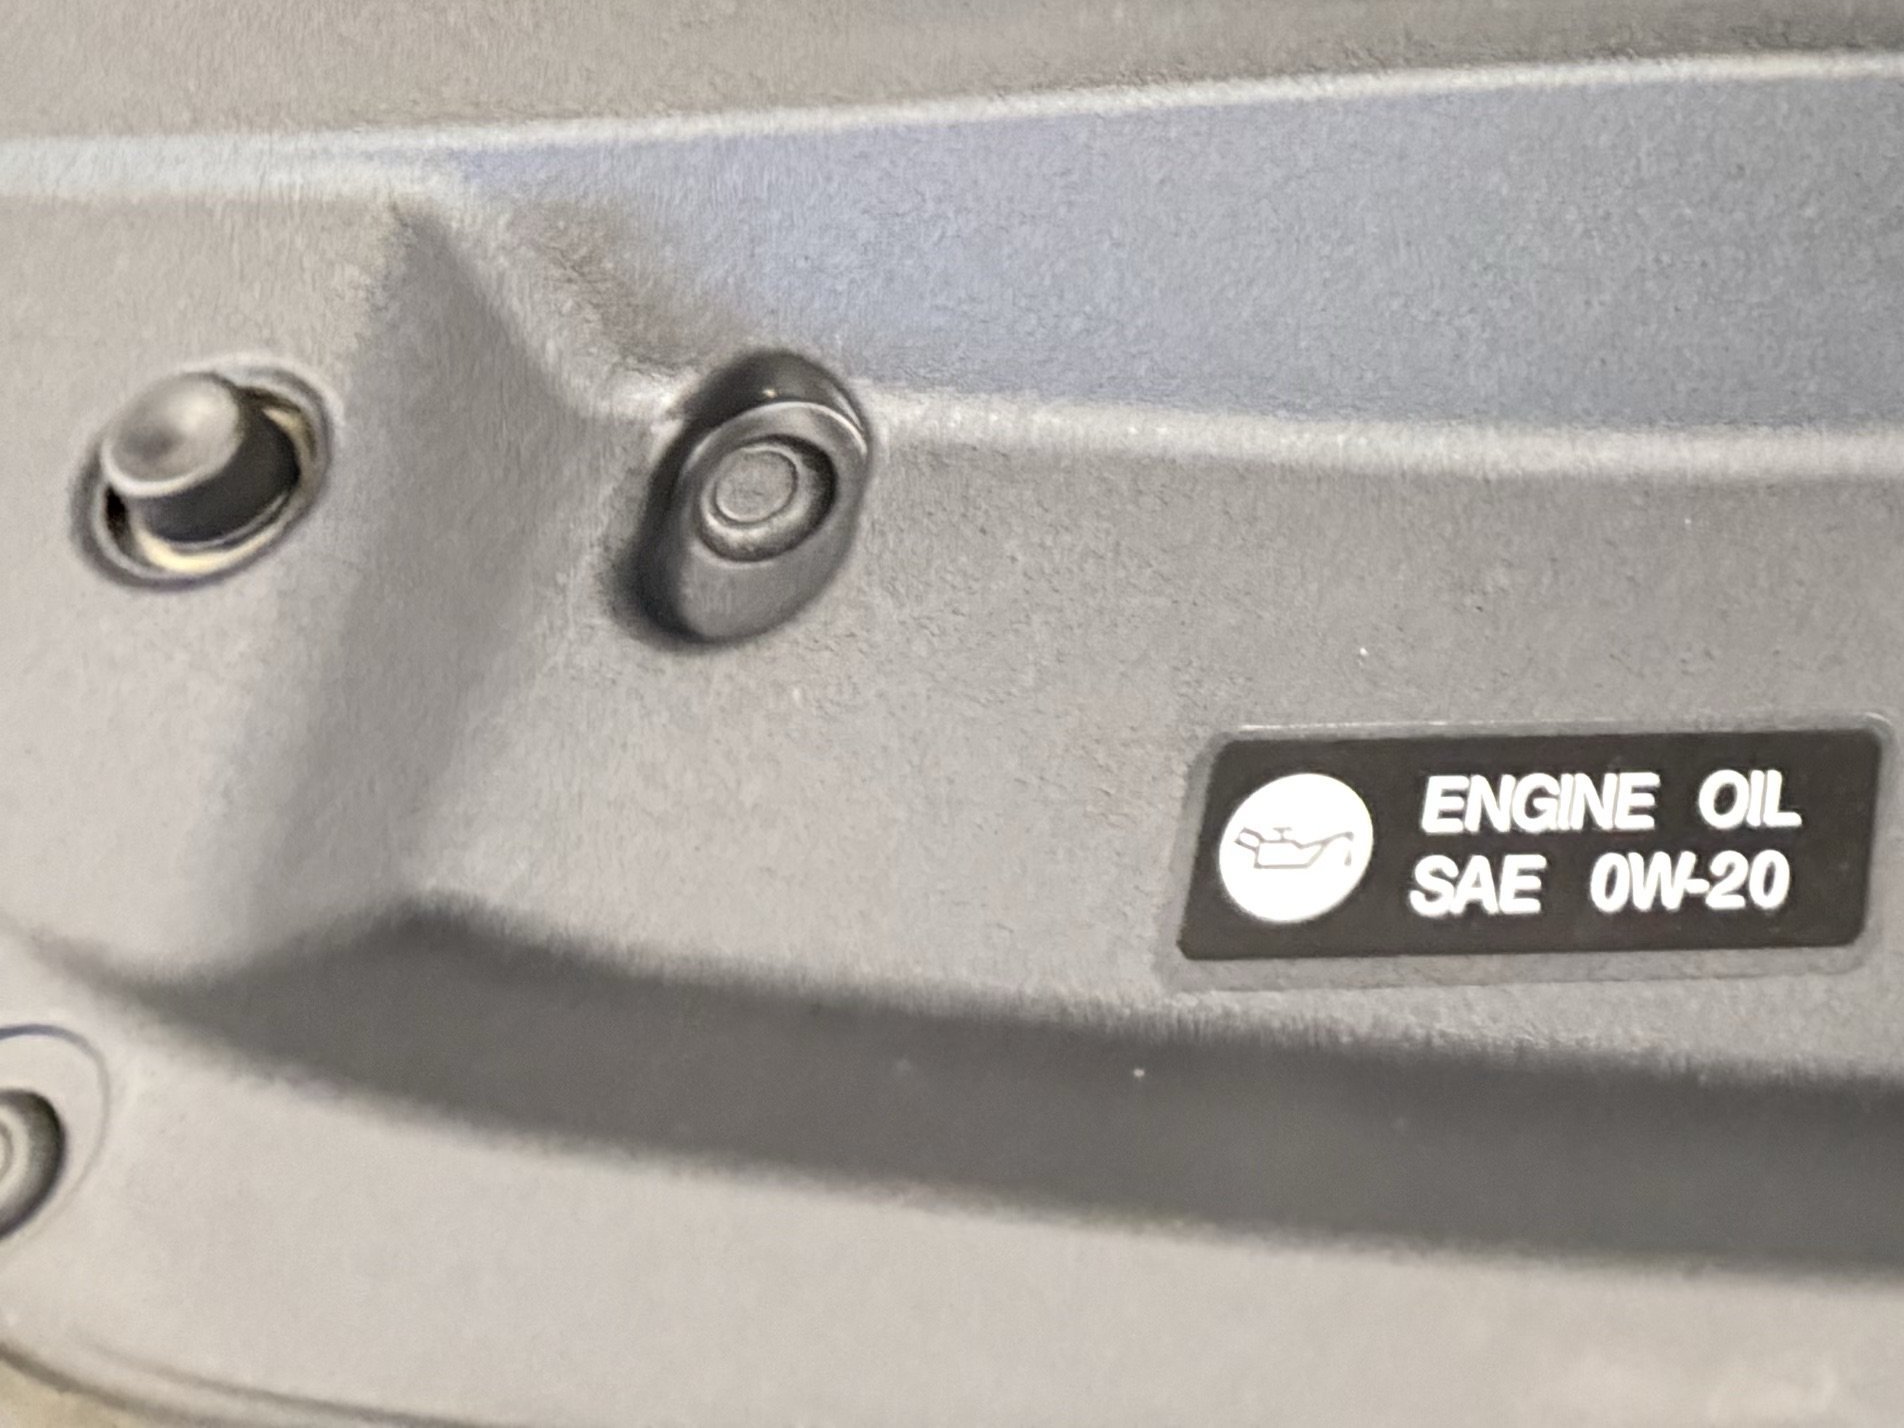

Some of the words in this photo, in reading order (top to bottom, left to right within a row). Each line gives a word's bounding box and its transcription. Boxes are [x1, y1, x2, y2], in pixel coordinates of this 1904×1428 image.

[1420, 771, 1660, 835] ENGINE
[1698, 769, 1802, 830] OIL
[1408, 853, 1547, 918] SAE
[1590, 848, 1791, 912] 0W-20
